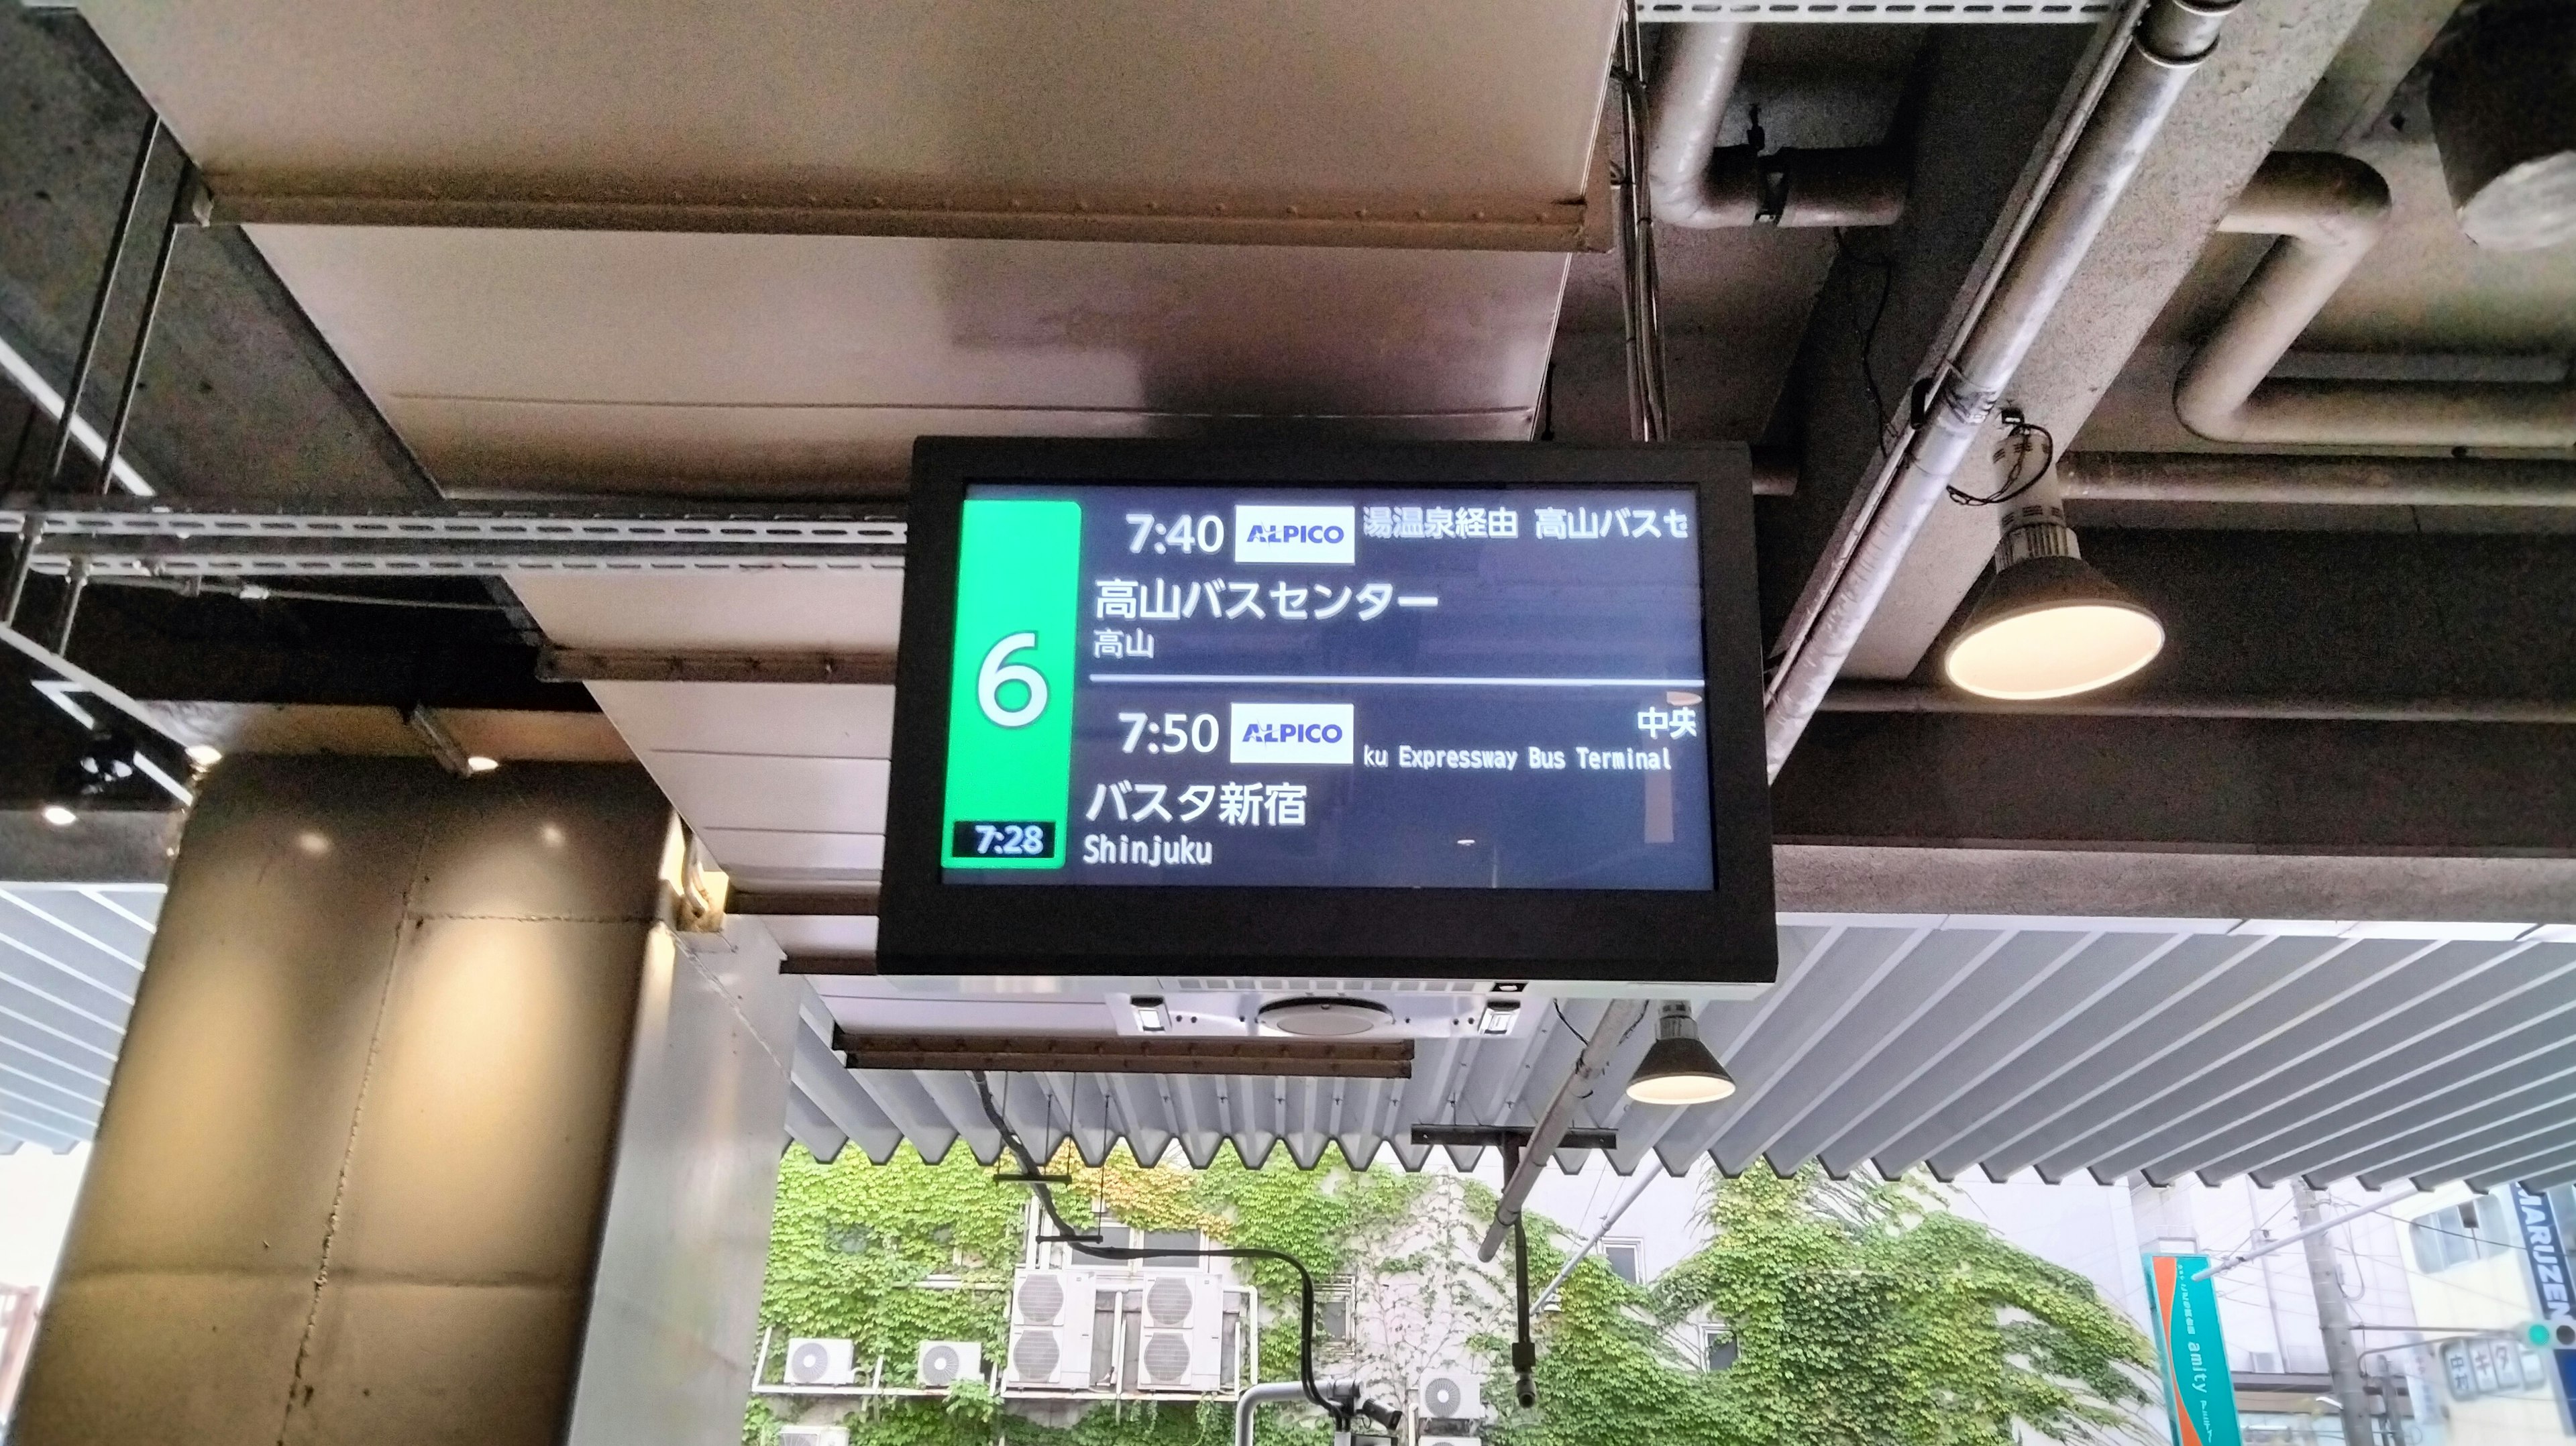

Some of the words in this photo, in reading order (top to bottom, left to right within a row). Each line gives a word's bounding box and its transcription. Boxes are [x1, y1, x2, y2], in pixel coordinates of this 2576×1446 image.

[1126, 513, 1225, 555] 7:40
[1246, 522, 1346, 545] ALPICO
[1362, 506, 1519, 539] 湯温泉経由
[1095, 577, 1439, 621] 高山バスセンター
[1093, 628, 1155, 659] 高山
[977, 631, 1049, 728] 6
[1118, 712, 1220, 755] 7:50
[1242, 722, 1344, 745] ALPICO
[1637, 706, 1697, 740] 中央
[1363, 744, 1389, 768] ku
[1398, 745, 1519, 771] Expressway
[1528, 746, 1566, 770] Bus
[1575, 746, 1672, 771] Terminal
[1085, 779, 1308, 826] バスタ新宿
[975, 825, 1044, 854] 7:28
[1083, 834, 1213, 867] Shinjuku
[2188, 1341, 2208, 1393] amity
